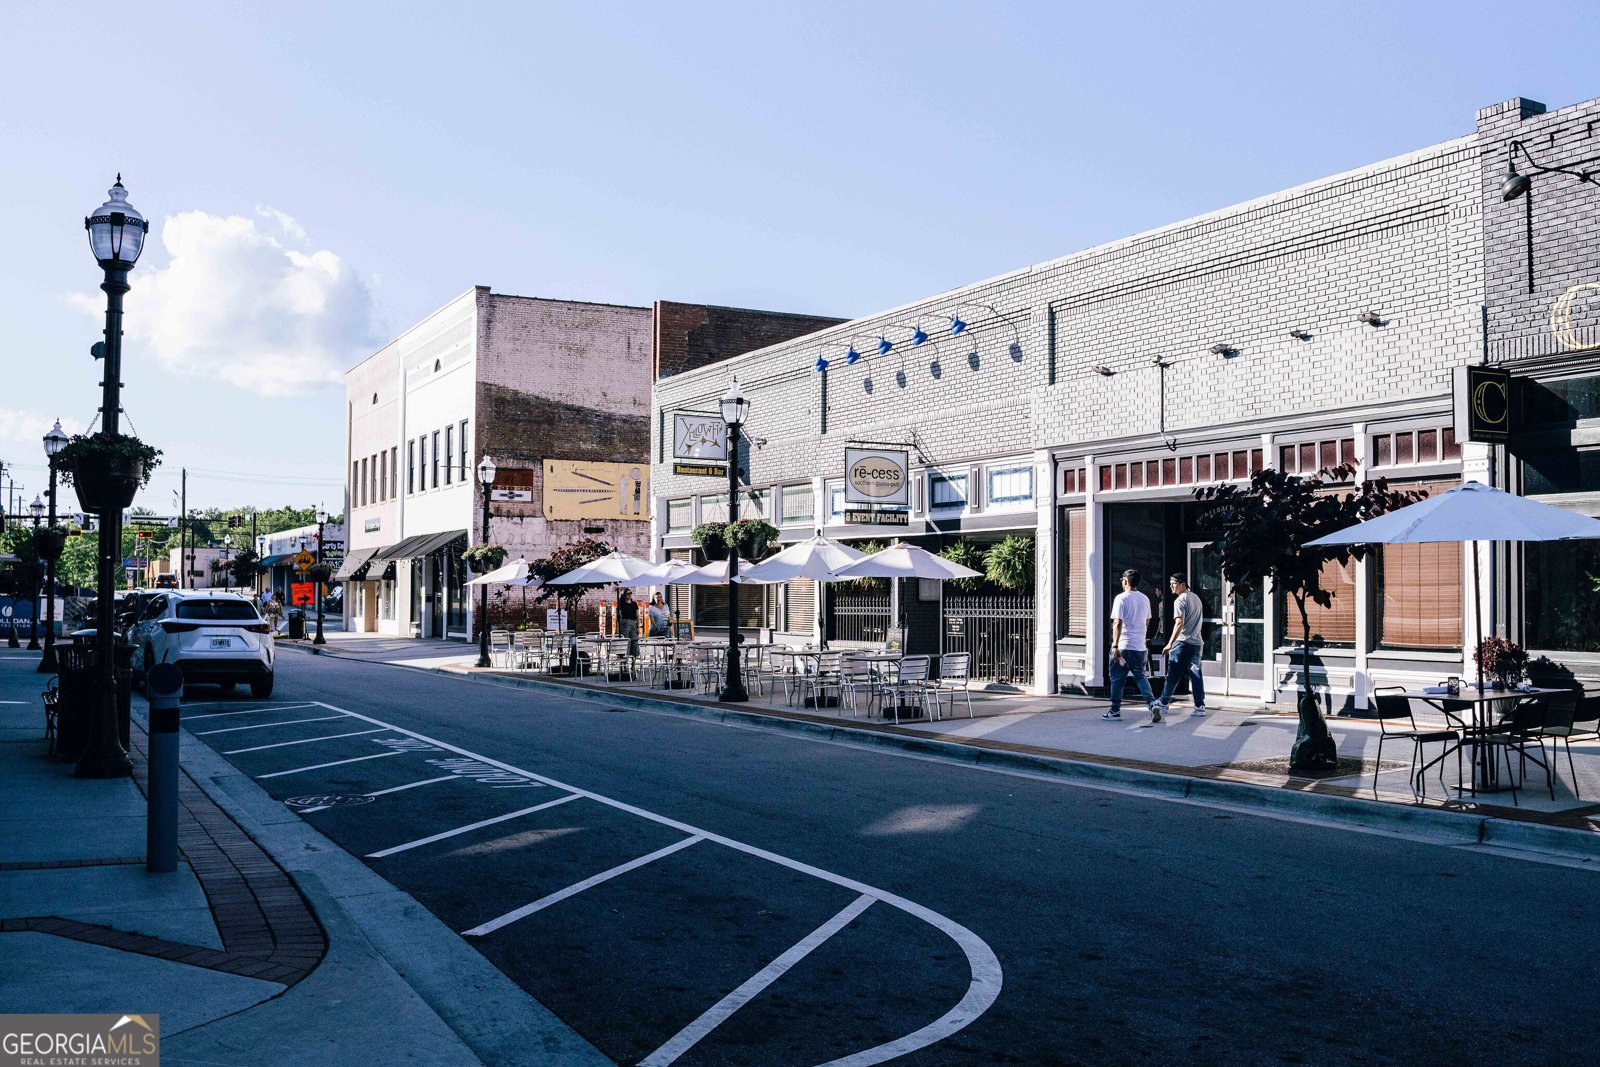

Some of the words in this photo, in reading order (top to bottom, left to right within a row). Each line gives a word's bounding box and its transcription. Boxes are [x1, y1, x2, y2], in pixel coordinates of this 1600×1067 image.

[1474, 381, 1507, 424] C
[676, 465, 707, 475] Restaurant
[714, 468, 724, 476] Bar
[845, 512, 851, 522] &
[852, 512, 876, 522] EVENT
[876, 513, 908, 523] FACILITY
[424, 758, 547, 789] LOADING
